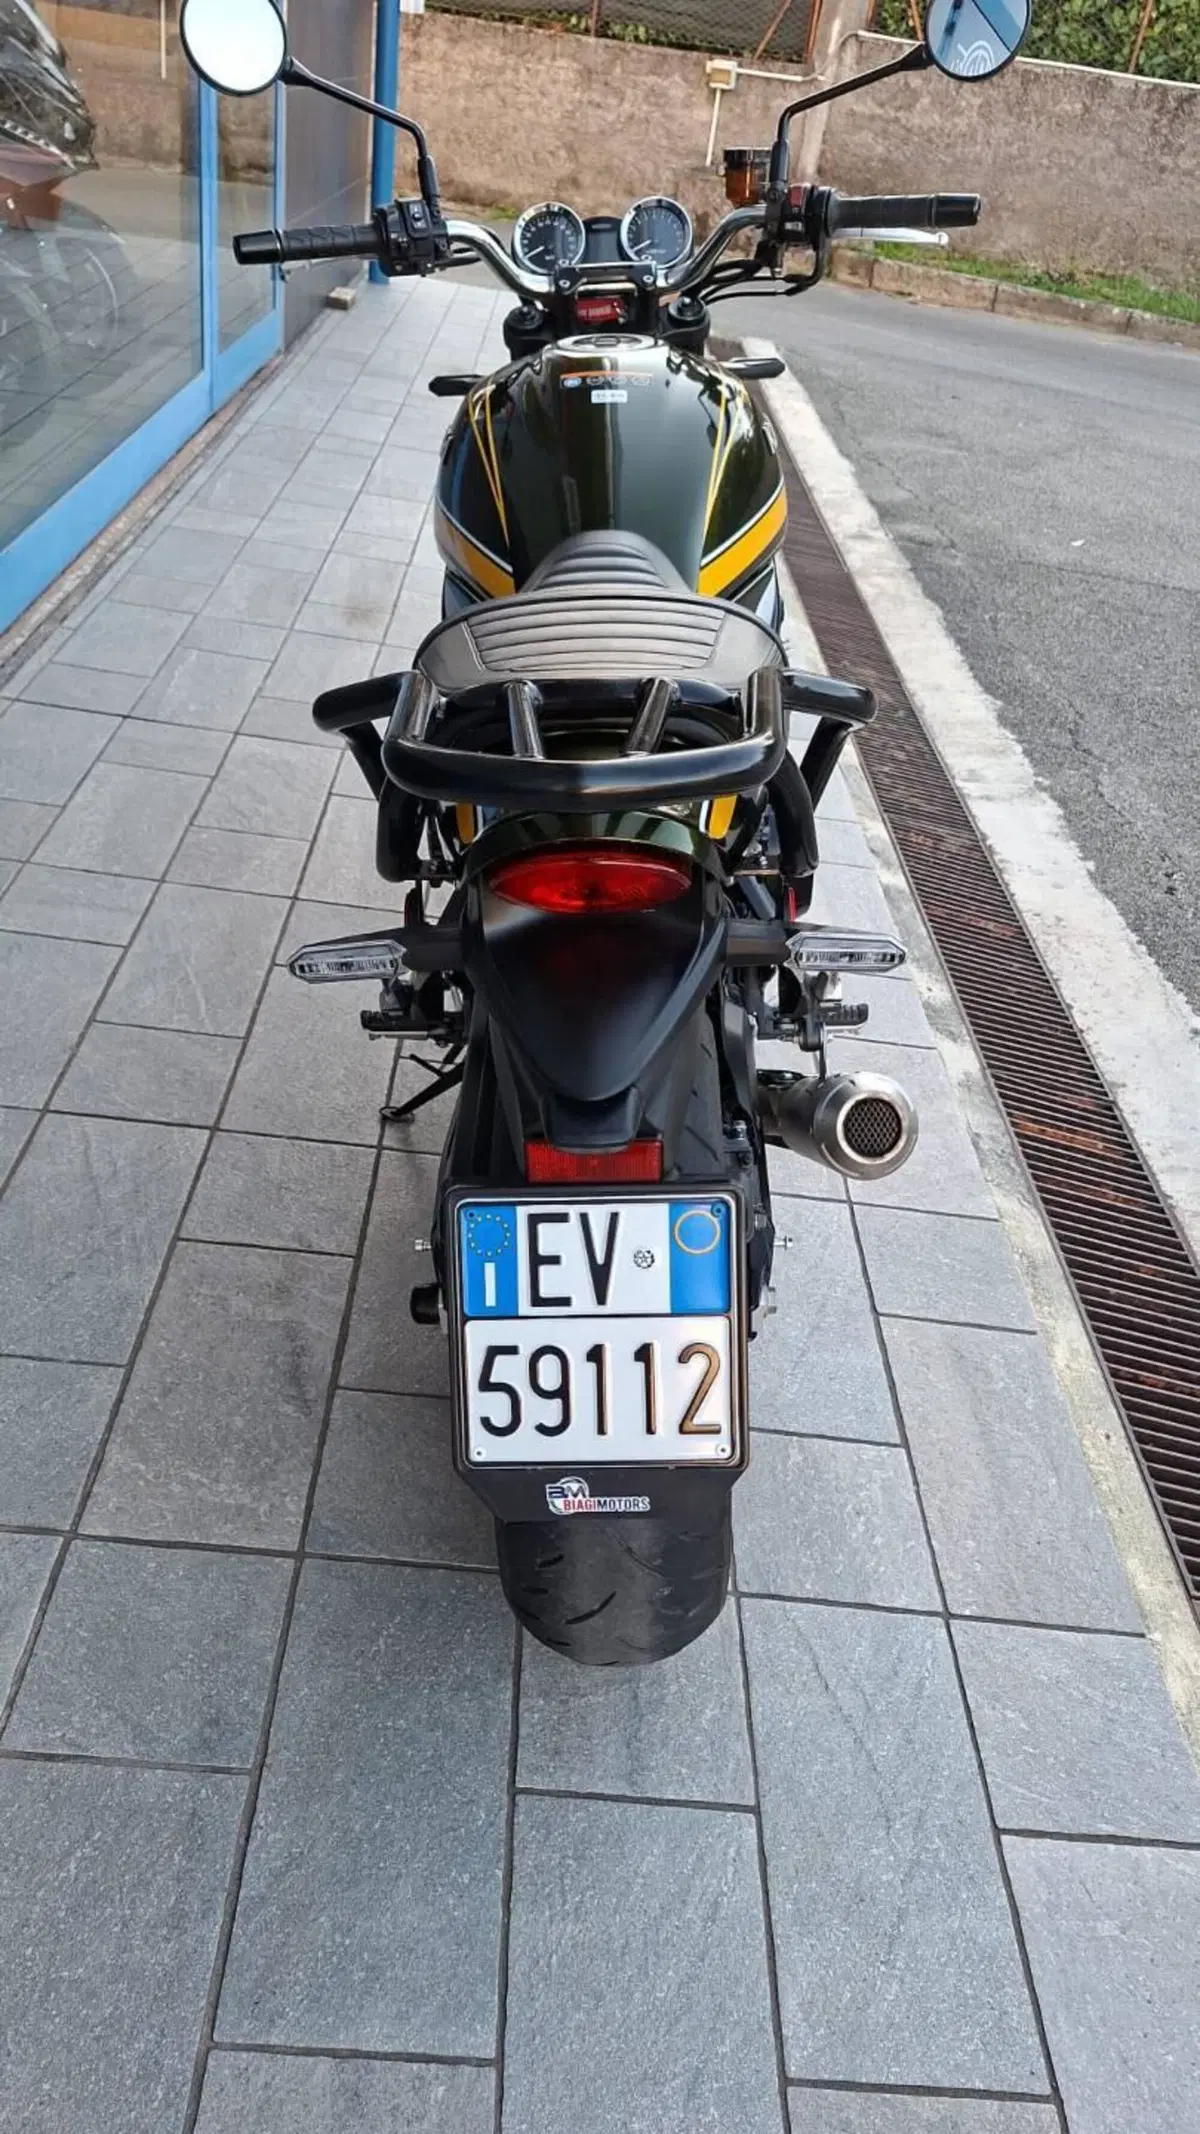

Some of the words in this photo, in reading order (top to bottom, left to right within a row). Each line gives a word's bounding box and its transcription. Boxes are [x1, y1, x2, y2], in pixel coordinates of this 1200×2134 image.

[527, 1212, 620, 1307] EV
[478, 1342, 722, 1437] 59112
[563, 1498, 649, 1511] BIAGIMOTORS
